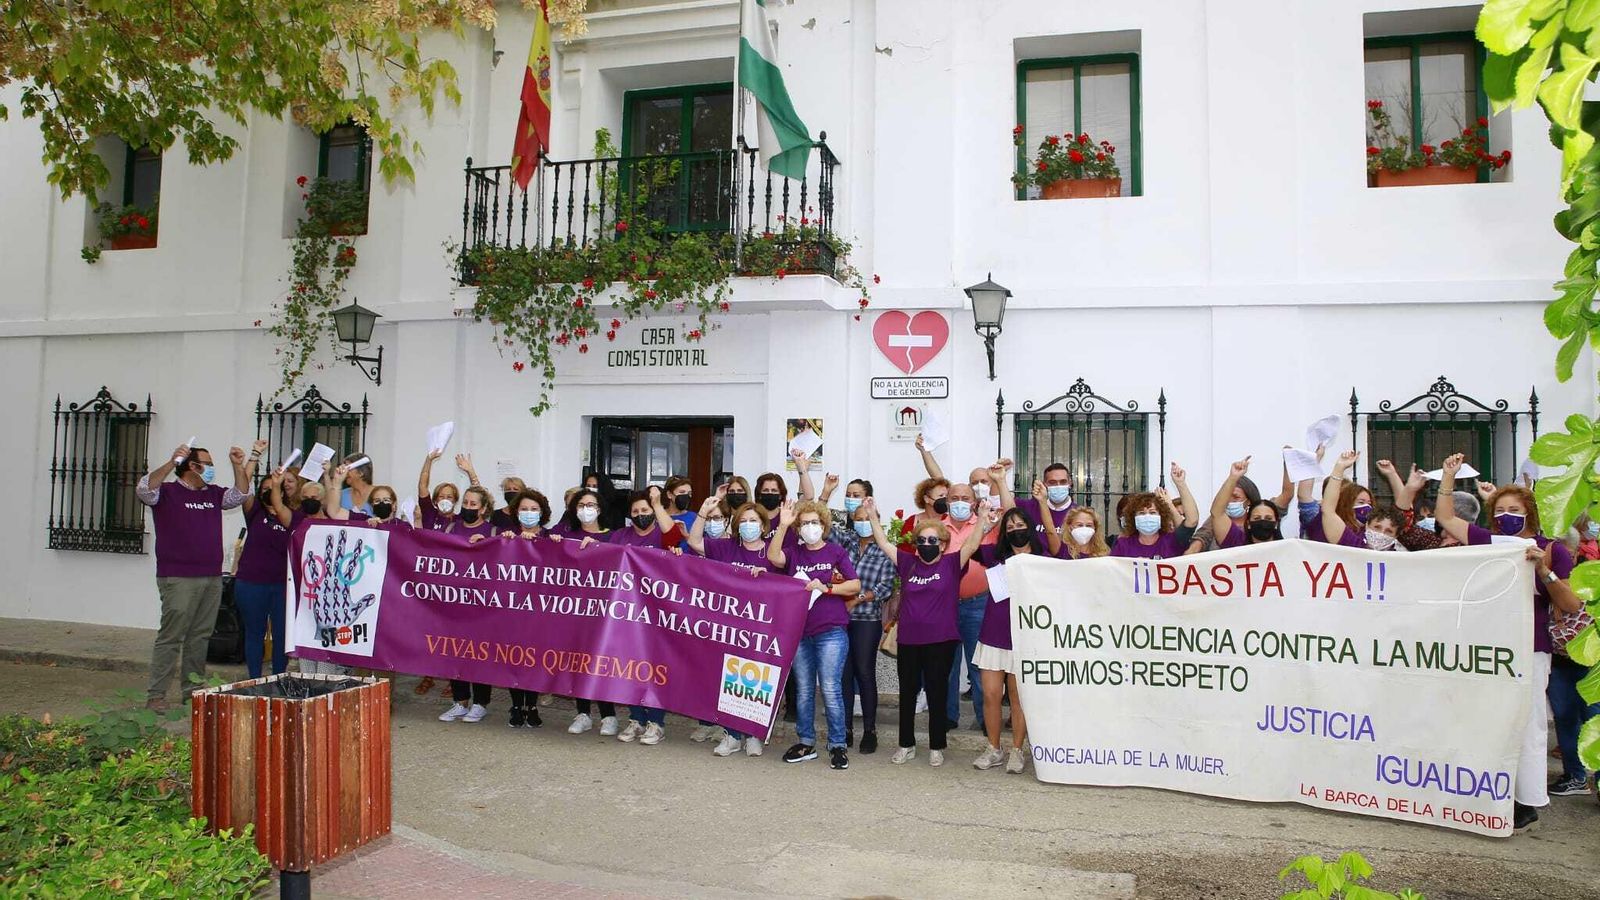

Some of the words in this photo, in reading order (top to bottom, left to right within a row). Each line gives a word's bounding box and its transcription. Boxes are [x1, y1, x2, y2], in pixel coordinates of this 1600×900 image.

[641, 328, 675, 345] CASA
[607, 349, 709, 367] CONSISTORIAL
[900, 388, 931, 396] GÉNERO
[904, 380, 945, 388] VIOLENCIA
[414, 555, 459, 577] FED.
[463, 561, 492, 580] AA
[497, 563, 537, 584] MM
[542, 567, 635, 591] RURALES
[640, 576, 684, 604] SOL
[690, 587, 773, 624] RURAL
[1302, 561, 1354, 600] YA
[337, 631, 352, 640] STOP
[400, 580, 503, 608] CONDENA
[508, 592, 534, 611] LA
[538, 594, 652, 625] VIOLENCIA
[657, 609, 782, 657] MACHISTA
[1018, 605, 1053, 630] NO
[1053, 624, 1104, 649] MAS
[1108, 624, 1237, 655] VIOLENCIA
[1244, 630, 1359, 665] CONTRA
[1373, 639, 1410, 668] LA
[1416, 641, 1523, 678] MUJER.
[425, 634, 490, 661] VIVAS
[494, 643, 536, 668] NOS
[543, 649, 669, 686] QUEREMOS
[725, 657, 773, 693] SOL
[723, 681, 772, 708] RURAL
[1257, 705, 1376, 742] JUSTICIA
[1031, 745, 1118, 765] ONCEJALIA
[1123, 750, 1142, 766] DE
[1149, 752, 1169, 768] LA
[1176, 754, 1229, 776] MUJER.
[1300, 783, 1318, 798] LA
[1325, 789, 1379, 809] BARCA
[1387, 798, 1409, 813] DE
[1413, 802, 1434, 817] LA
